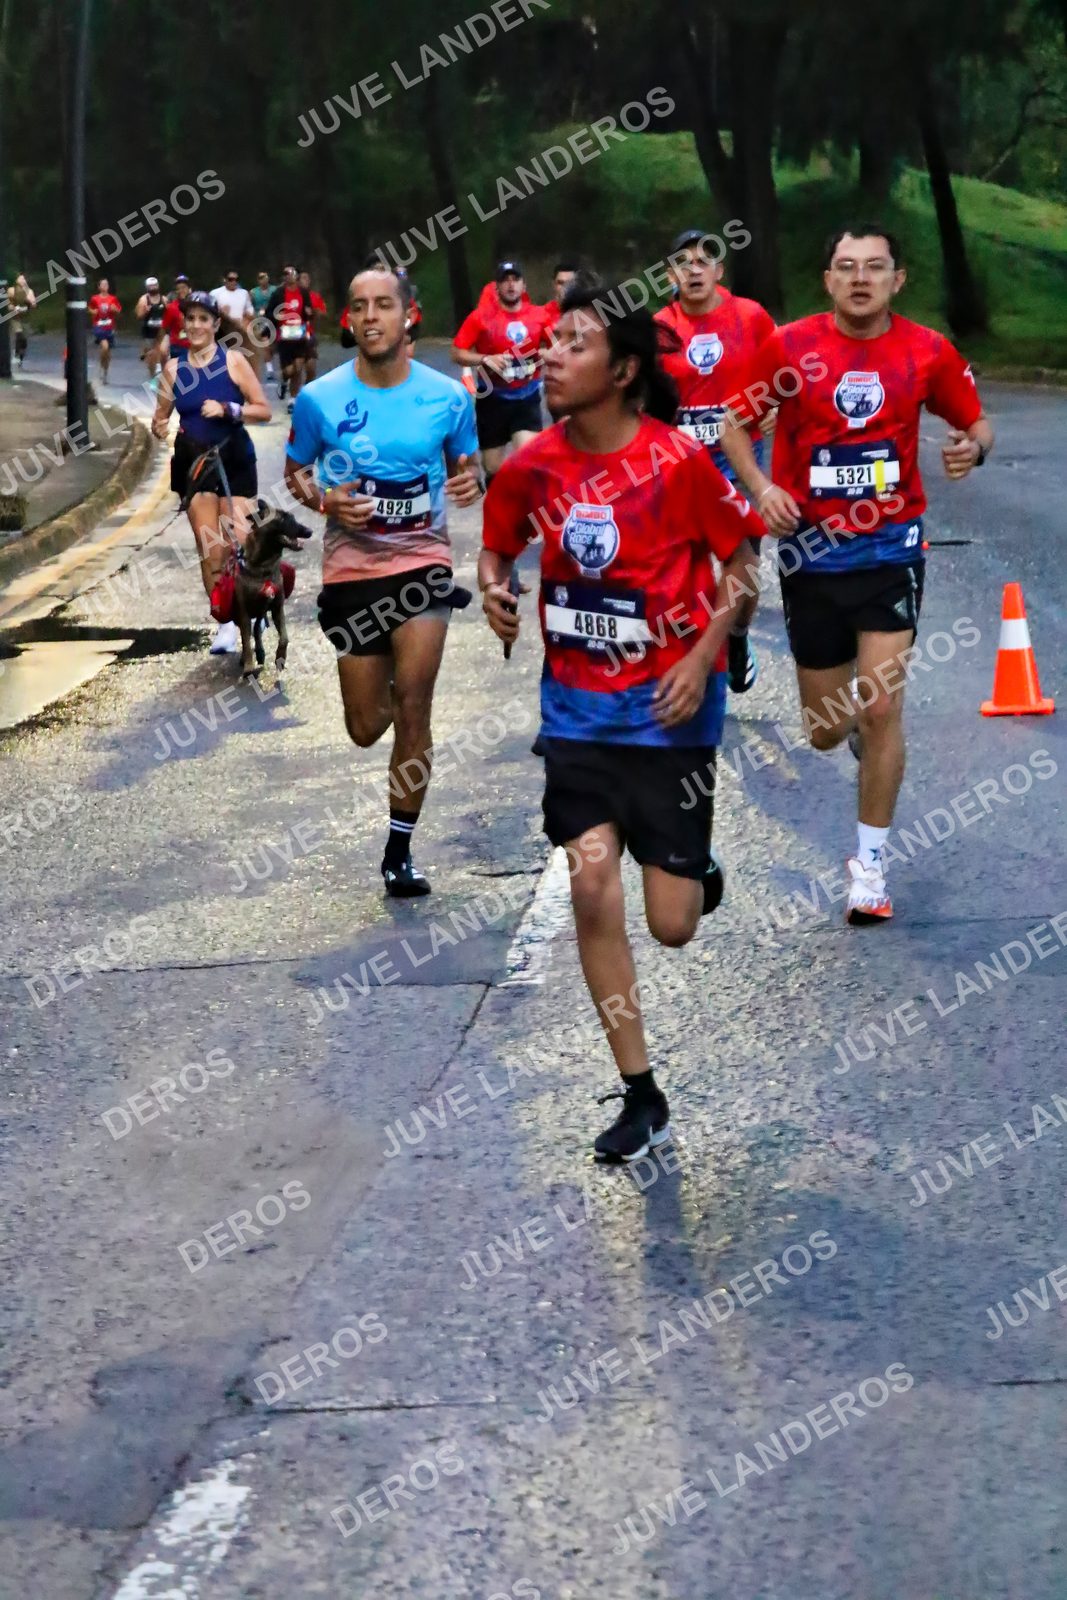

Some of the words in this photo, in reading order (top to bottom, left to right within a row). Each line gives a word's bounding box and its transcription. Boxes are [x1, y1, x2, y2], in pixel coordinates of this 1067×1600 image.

[836, 466, 872, 485] 5321
[376, 499, 413, 516] 4929
[576, 522, 606, 534] Global
[570, 533, 593, 545] Race
[574, 611, 618, 639] 4868
